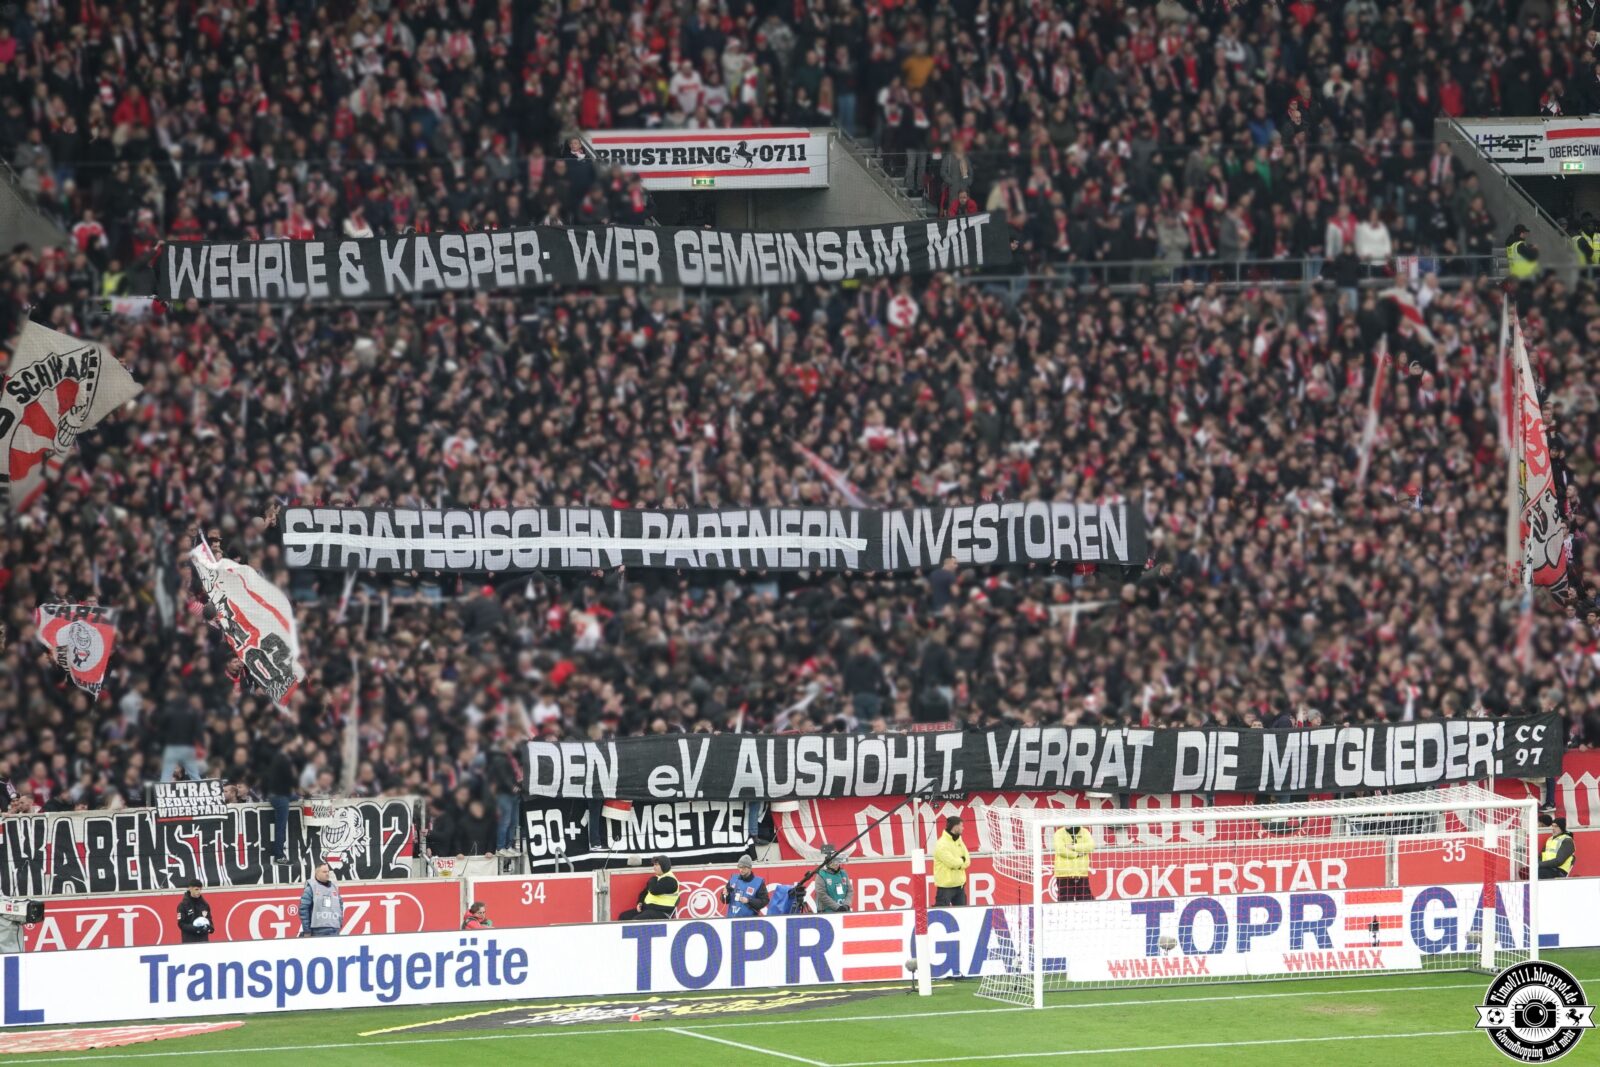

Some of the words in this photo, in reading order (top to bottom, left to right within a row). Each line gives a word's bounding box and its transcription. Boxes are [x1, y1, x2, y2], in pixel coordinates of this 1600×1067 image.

[759, 143, 807, 162] 0711
[1549, 144, 1600, 159] OBERSCHW
[168, 241, 328, 299] WEHRLE
[338, 241, 370, 296] &
[380, 230, 552, 294] KASPER:
[567, 227, 662, 284] WER
[674, 226, 910, 286] GEMEINSAM
[927, 213, 990, 271] MIT
[284, 508, 623, 571] STRATEGISCHEN
[641, 510, 859, 569] PARTNERN
[882, 502, 1129, 570] INVESTOREN
[1515, 725, 1547, 743] CC
[528, 741, 618, 798] DEN
[729, 731, 964, 798] AUSHÖHLT,
[987, 727, 1154, 790] VERRÄT
[1173, 731, 1239, 792] DIE
[1258, 720, 1505, 791] MITGLIEDER!
[1515, 747, 1544, 766] 97
[155, 781, 221, 798] ULTRAS
[158, 804, 228, 817] WIDERSTAND
[1442, 840, 1466, 863] 35
[1094, 859, 1348, 900] JOKERSTAR
[521, 882, 546, 905] 34
[316, 911, 341, 920] FOTO
[1107, 956, 1210, 978] WINAMAX
[1283, 950, 1386, 972] WINAMAX
[140, 938, 530, 1008] Transportgeräte
